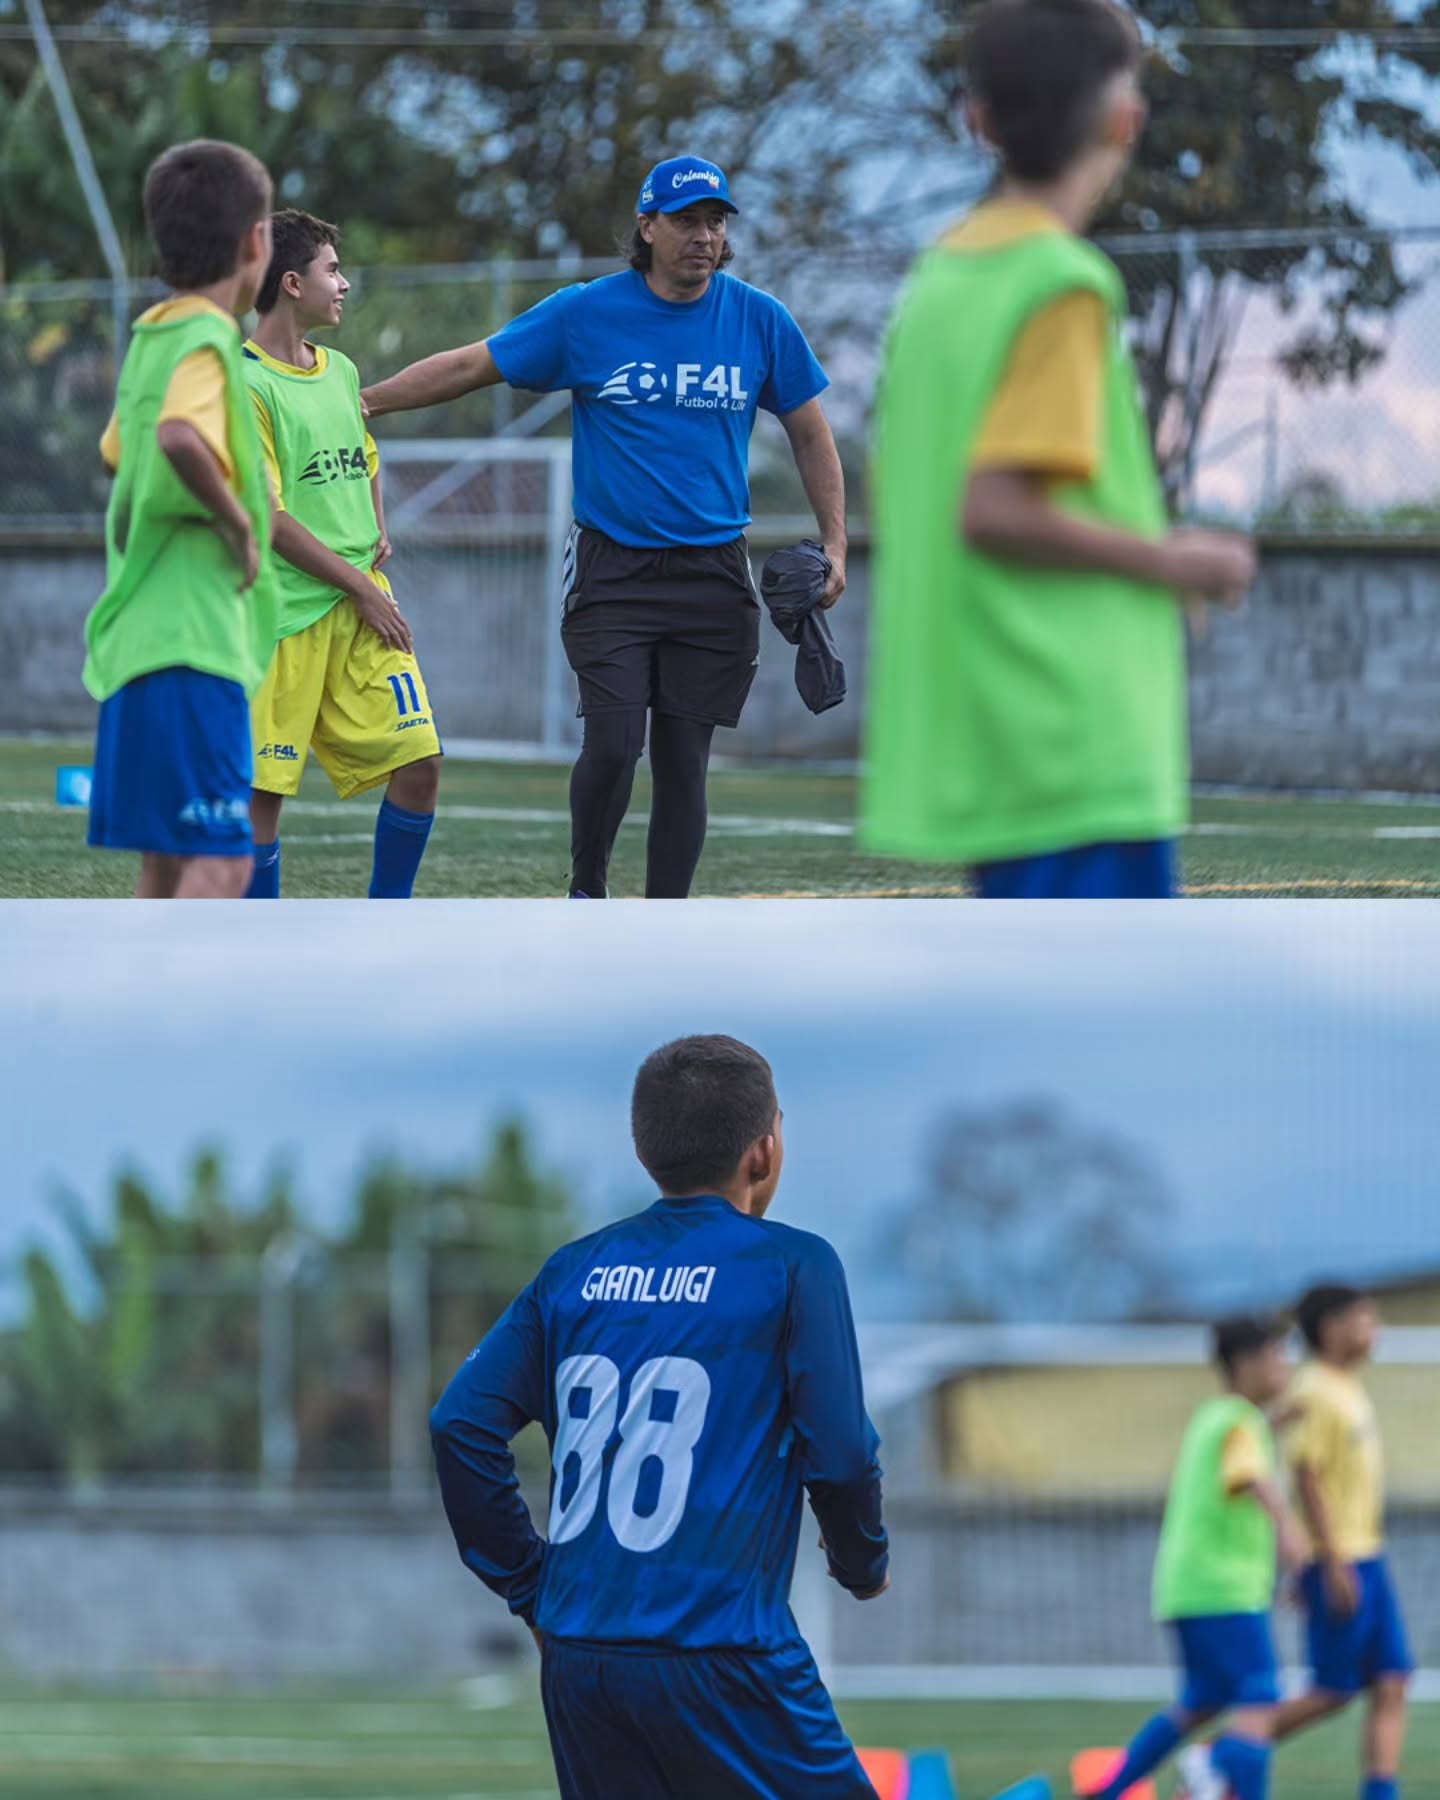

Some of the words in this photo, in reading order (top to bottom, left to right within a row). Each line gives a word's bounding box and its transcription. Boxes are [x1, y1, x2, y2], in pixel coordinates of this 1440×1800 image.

[675, 363, 748, 401] F4L
[675, 396, 718, 409] Futbol
[721, 400, 729, 410] 4
[731, 400, 746, 411] Li
[387, 672, 421, 716] 11
[274, 744, 298, 758] F4L
[581, 1265, 716, 1303] GIANLUIGI
[548, 1354, 712, 1553] 88
